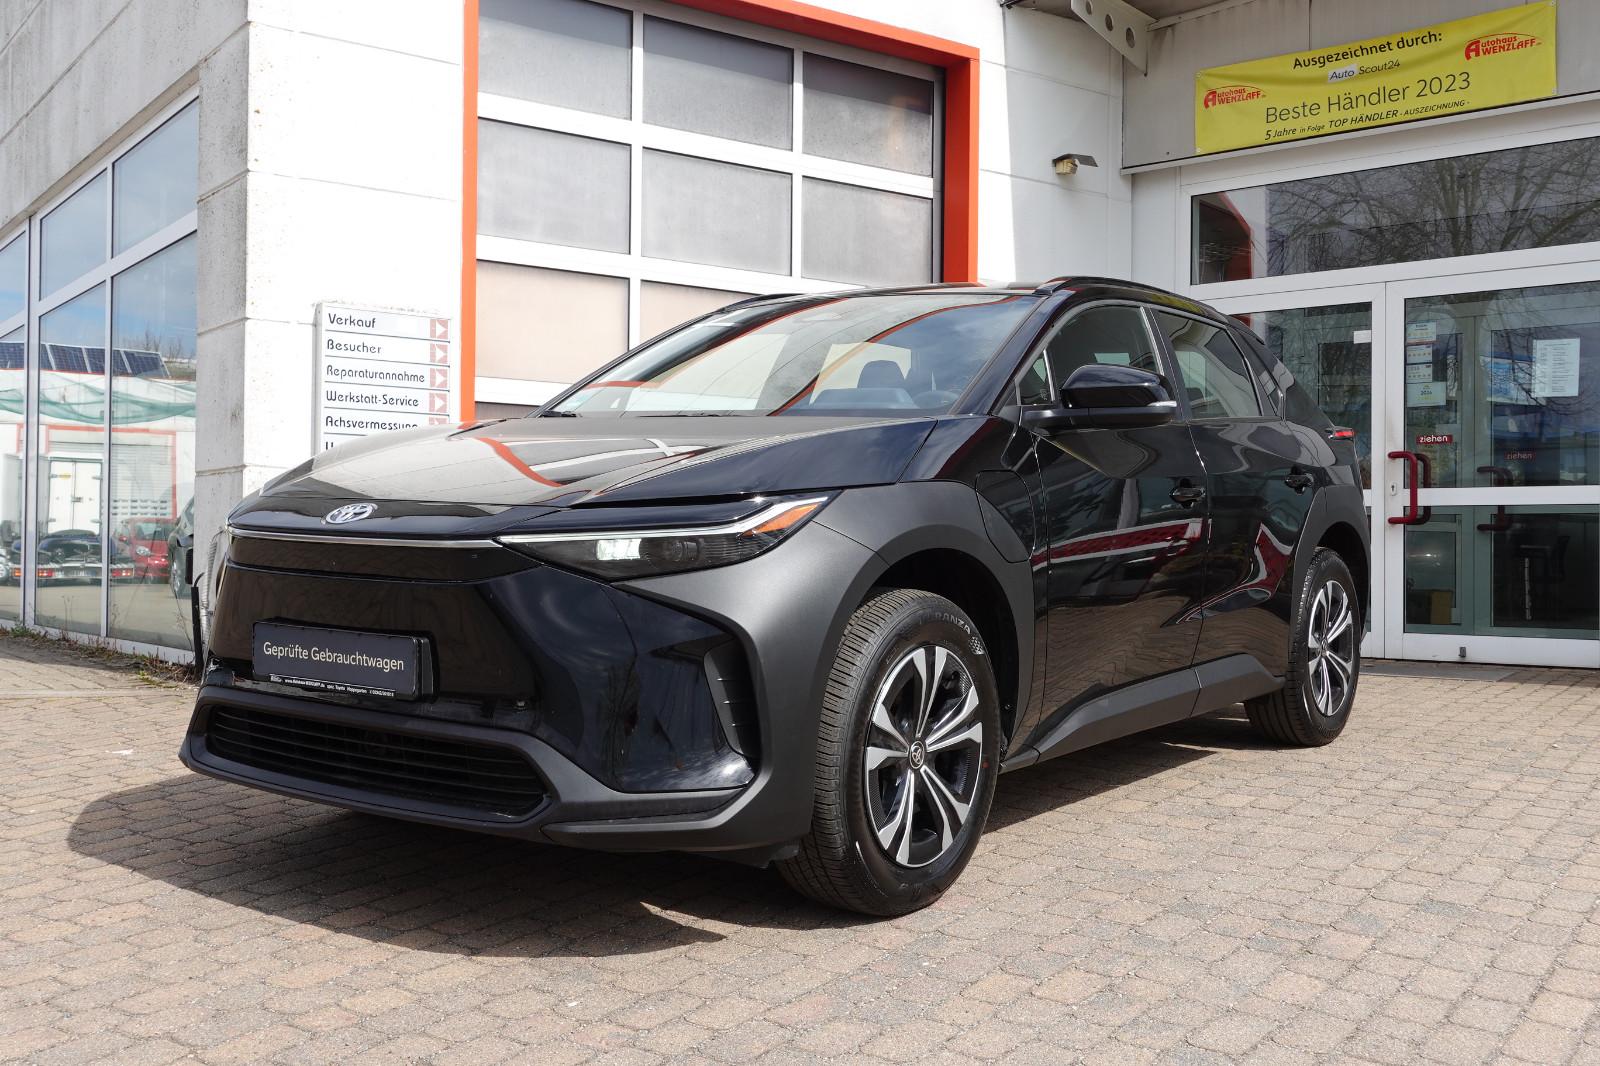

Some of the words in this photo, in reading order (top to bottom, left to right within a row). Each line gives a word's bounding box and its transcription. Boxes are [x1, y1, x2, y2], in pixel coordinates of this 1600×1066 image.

[1293, 40, 1393, 69] Ausgezeichnet
[1396, 30, 1443, 49] durch:
[1481, 38, 1536, 56] WENZLAFF
[1217, 90, 1261, 105] WENZLAFF
[1265, 101, 1321, 124] Beste
[1327, 85, 1410, 113] Händler
[1416, 71, 1472, 98] 2023
[1264, 129, 1272, 140] 5
[1272, 127, 1297, 138] Jahre
[1306, 124, 1325, 133] Folge
[1329, 117, 1349, 128] TOP
[1350, 109, 1399, 125] HÄNDLER
[328, 313, 376, 329] Verkauf
[326, 338, 382, 354] Besucher
[326, 364, 425, 383] Reparaturannahme
[326, 390, 419, 407] Werkstatt-Service
[1419, 434, 1448, 443] ziehen
[1506, 452, 1533, 460] ziehen
[263, 641, 309, 660] Geprüfte
[310, 647, 405, 673] Gebrauchtwagen
